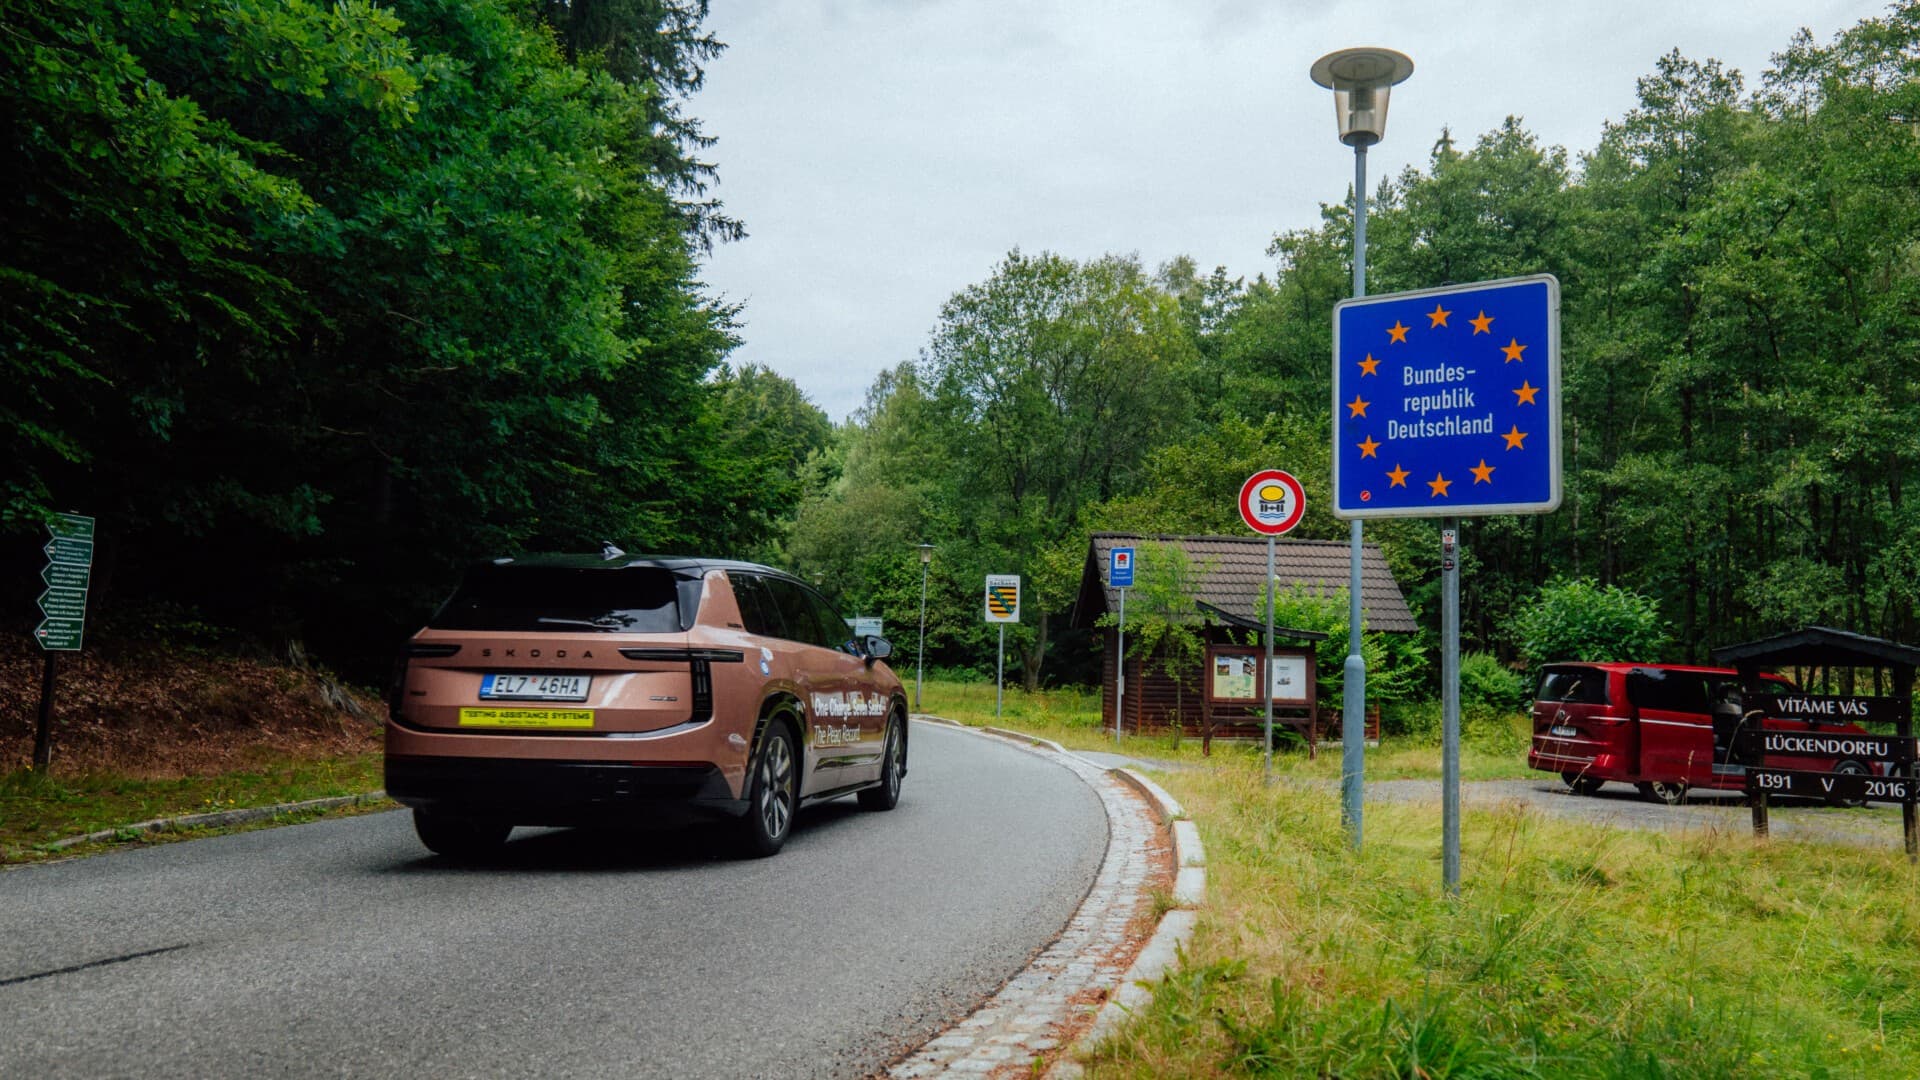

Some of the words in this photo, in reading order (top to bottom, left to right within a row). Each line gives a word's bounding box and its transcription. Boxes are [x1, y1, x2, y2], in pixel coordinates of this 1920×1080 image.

[1403, 363, 1476, 386] Bundes-
[1404, 388, 1475, 416] republik
[1388, 413, 1493, 439] Deutschland
[495, 676, 528, 693] EL7
[539, 678, 579, 695] 46HA
[500, 711, 548, 719] ASSISTANCE
[1766, 734, 1888, 756] LÜCKENDORFU
[1756, 774, 1791, 789] 1391
[1821, 778, 1834, 792] V
[1865, 781, 1906, 797] 2016
